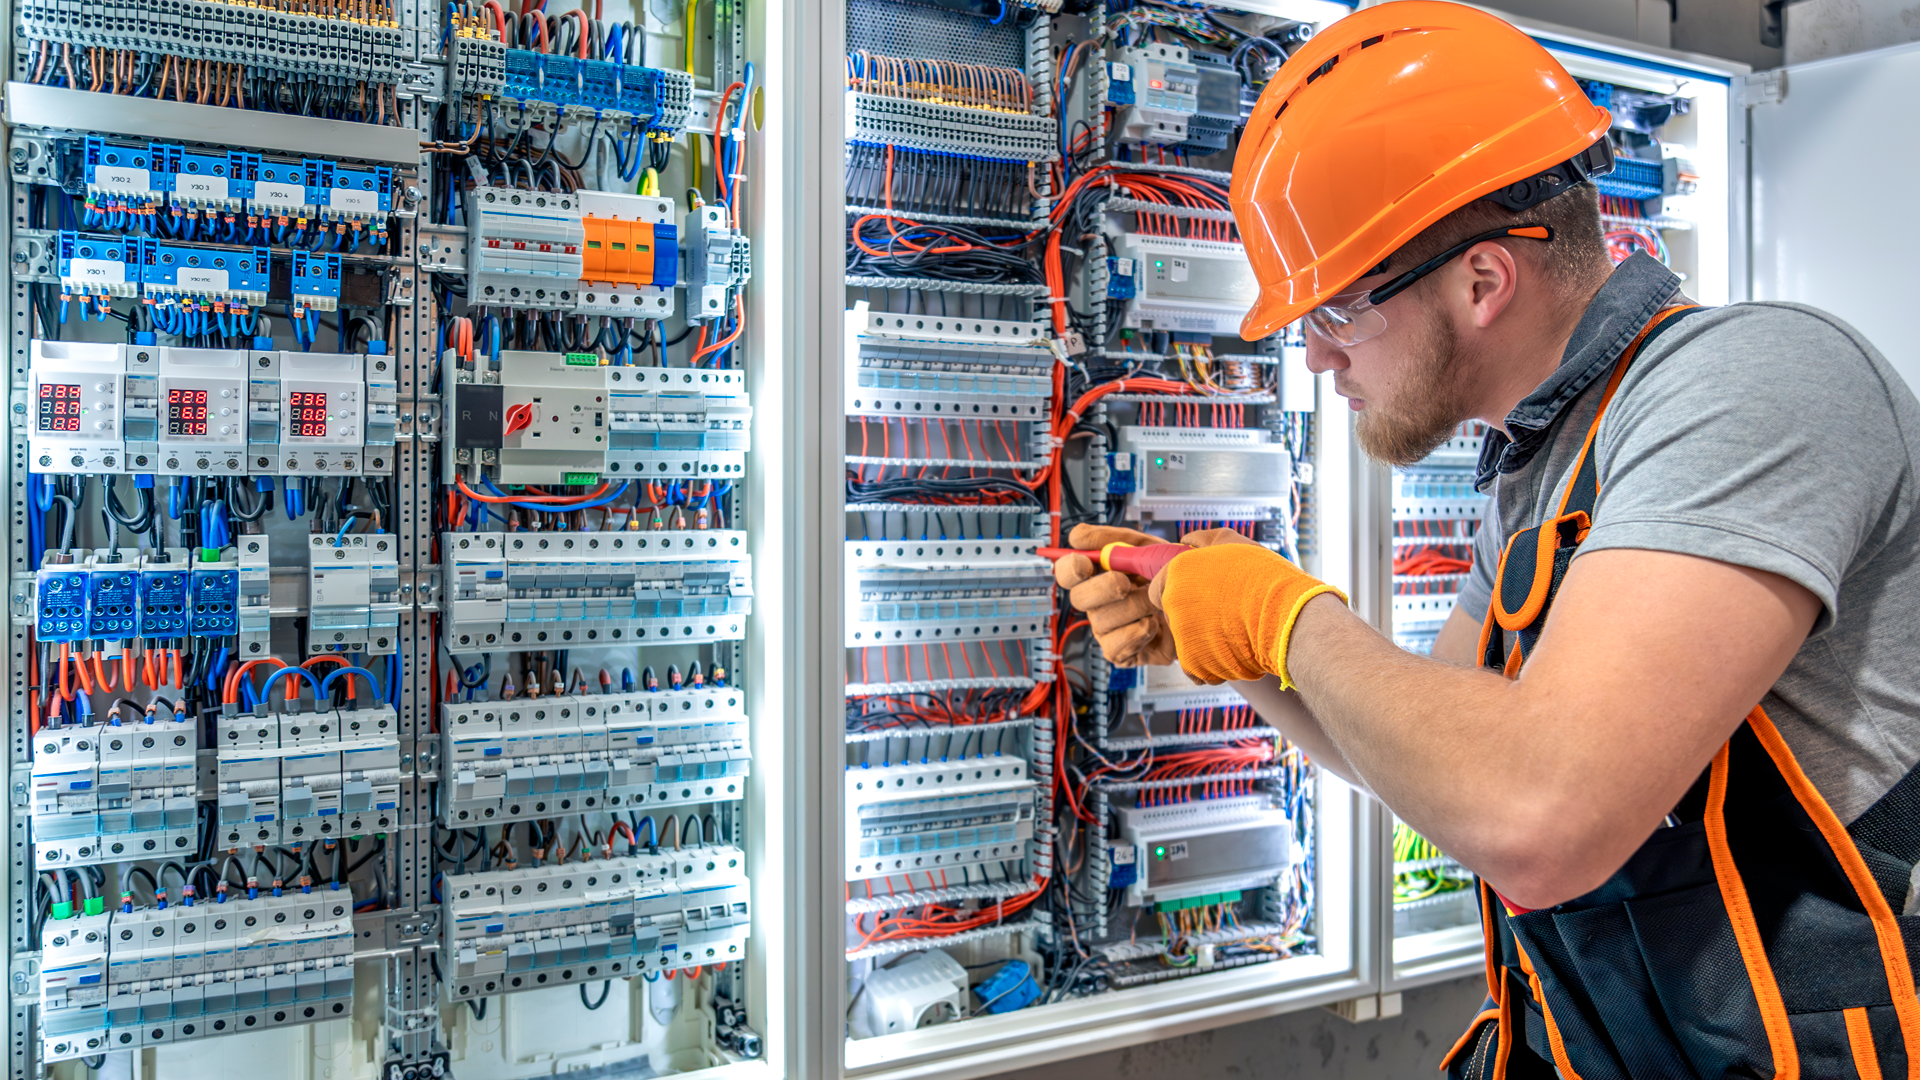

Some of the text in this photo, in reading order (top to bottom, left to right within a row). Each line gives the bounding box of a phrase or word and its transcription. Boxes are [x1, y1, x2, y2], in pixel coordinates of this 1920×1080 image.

[40, 385, 80, 398] 234
[169, 390, 206, 404] 228
[290, 393, 326, 406] 236
[182, 407, 206, 420] 6.3
[302, 408, 326, 421] 0.0
[462, 410, 497, 420] R N
[53, 417, 80, 430] 0.8
[302, 423, 326, 436] 0.0
